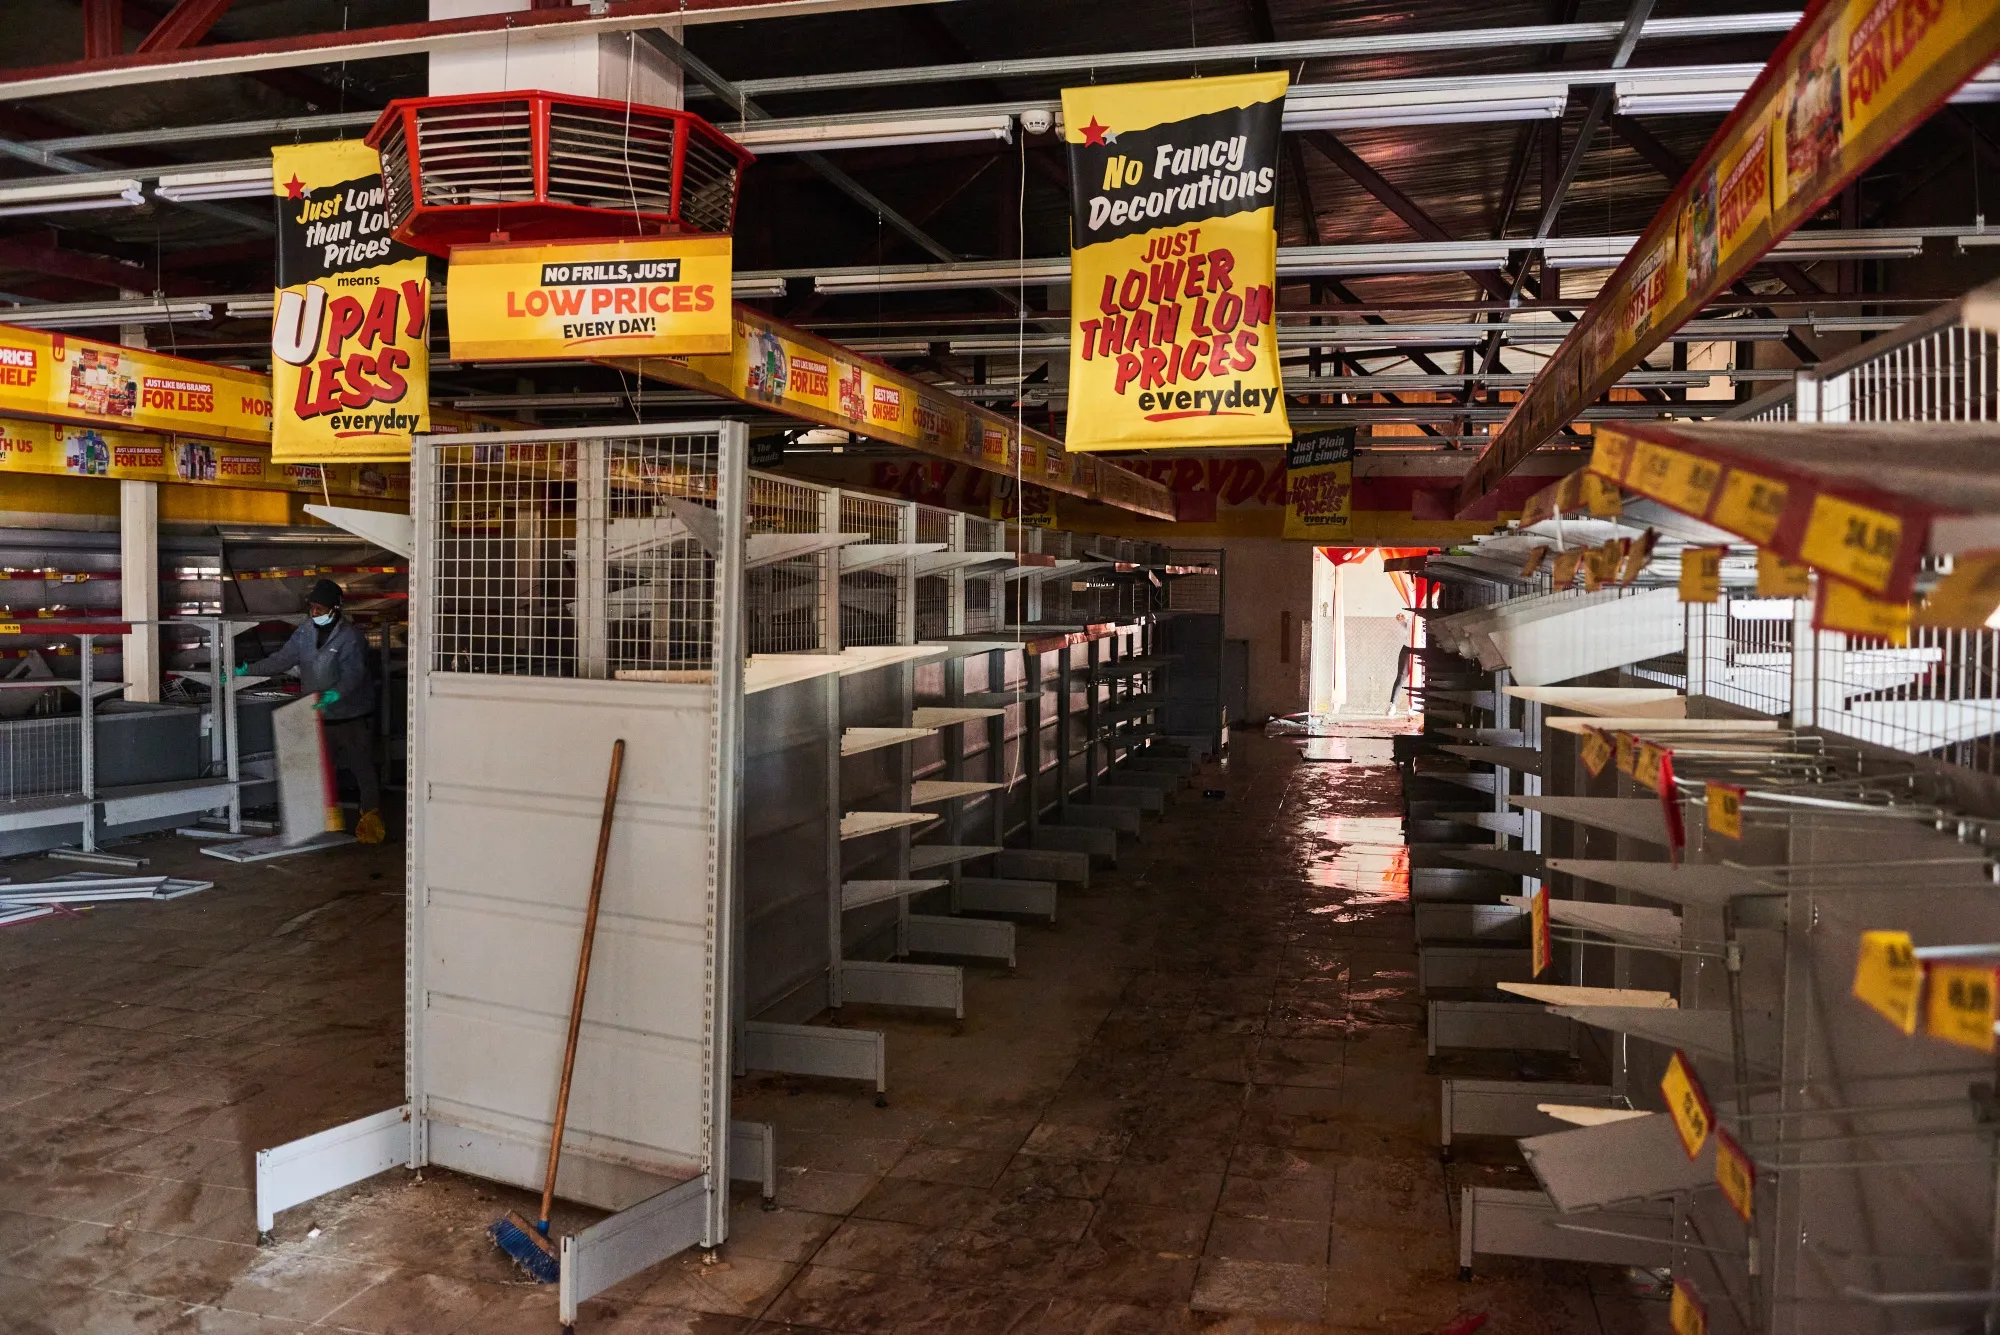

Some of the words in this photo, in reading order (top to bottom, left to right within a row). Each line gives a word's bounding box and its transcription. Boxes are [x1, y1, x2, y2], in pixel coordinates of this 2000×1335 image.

[1103, 155, 1143, 191] No
[1154, 135, 1248, 180] Fancy
[296, 194, 342, 224] Just
[1088, 167, 1274, 231] Decorations
[306, 220, 352, 248] than
[1141, 228, 1200, 263] JUST
[323, 237, 392, 268] Prices
[338, 276, 380, 287] means
[544, 266, 570, 282] NO
[572, 264, 632, 283] FRILLS,
[633, 262, 677, 280] JUST
[1100, 248, 1235, 316] LOWER
[507, 289, 588, 318] LOW
[592, 285, 715, 315] PRICES
[272, 284, 328, 367] U
[327, 277, 426, 358] PAY
[563, 320, 614, 338] EVERY
[619, 317, 656, 334] DAY!
[1080, 302, 1182, 360] THAN
[1191, 283, 1274, 337] LOW
[1114, 329, 1258, 395] PRICES
[146, 379, 161, 387] JUST
[162, 380, 176, 389] LIKE
[176, 382, 186, 390] BIG
[186, 383, 211, 392] BRANDS
[294, 347, 410, 421] LESS
[790, 370, 808, 392] FOR
[808, 374, 828, 397] LESS
[874, 387, 886, 402] BEST
[886, 390, 899, 404] PRICE
[142, 390, 174, 410] FOR
[178, 392, 214, 413] LESS
[1138, 380, 1279, 415] everyday
[330, 408, 420, 434] everyday
[872, 404, 882, 420] ON
[882, 405, 900, 422] SHELF
[912, 406, 935, 430] COSTS
[16, 440, 33, 453] US
[1292, 439, 1316, 453] Just
[1319, 435, 1344, 449] Plain
[1292, 452, 1312, 465] and
[1314, 447, 1348, 462] simple
[114, 454, 136, 467] FOR
[143, 455, 164, 468] LESS
[221, 463, 238, 474] FOR
[240, 464, 262, 476] LESS
[282, 465, 305, 478] LOW
[1304, 513, 1348, 526] everyday
